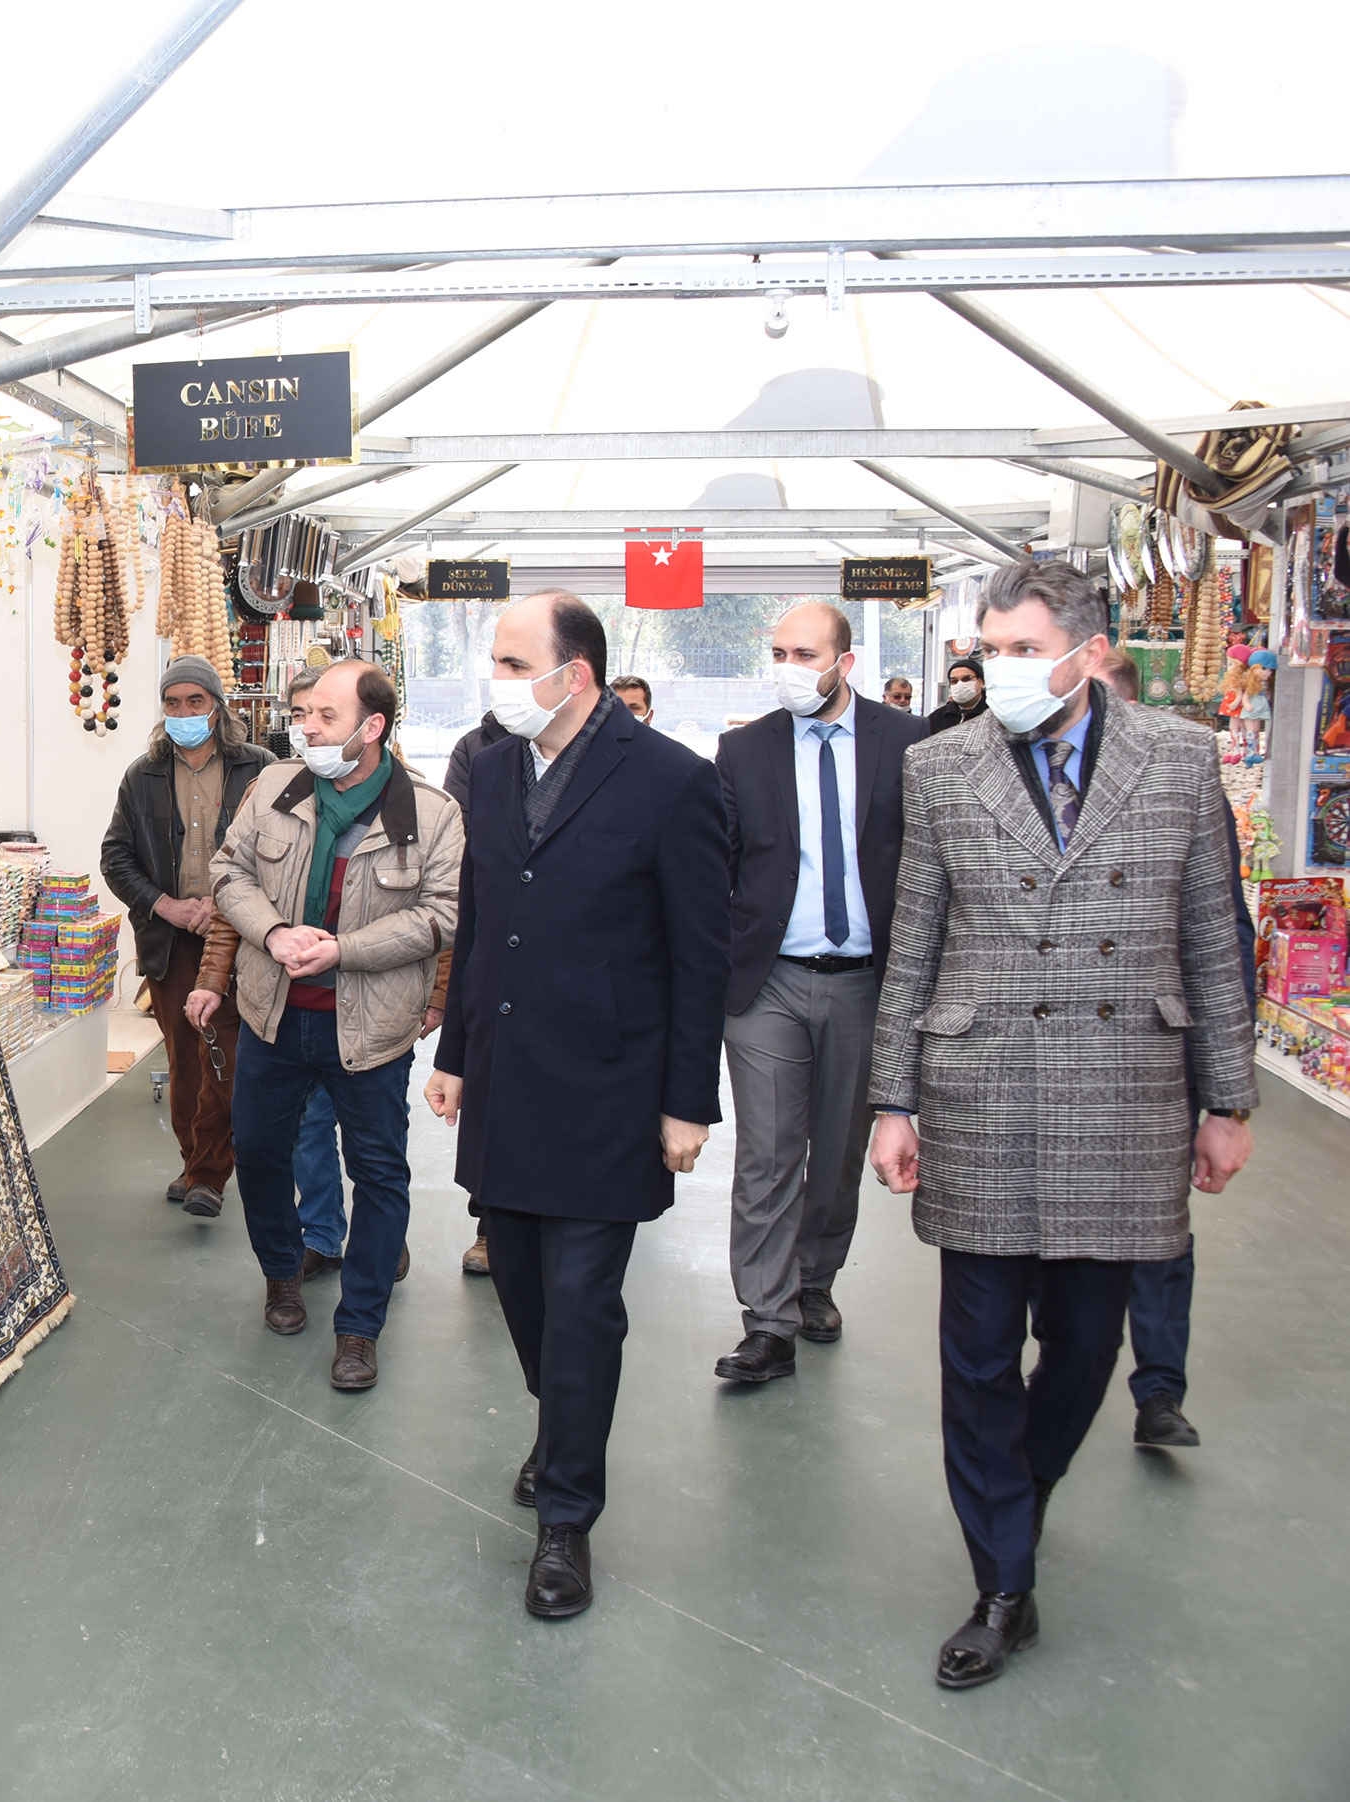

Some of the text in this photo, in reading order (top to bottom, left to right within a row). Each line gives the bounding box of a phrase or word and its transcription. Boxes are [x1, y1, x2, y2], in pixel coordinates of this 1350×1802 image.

[180, 377, 300, 407] CANSIN
[199, 410, 283, 441] BÜFE
[442, 580, 494, 592] DÜNYASI
[846, 580, 924, 593] ŞEKERLEME
